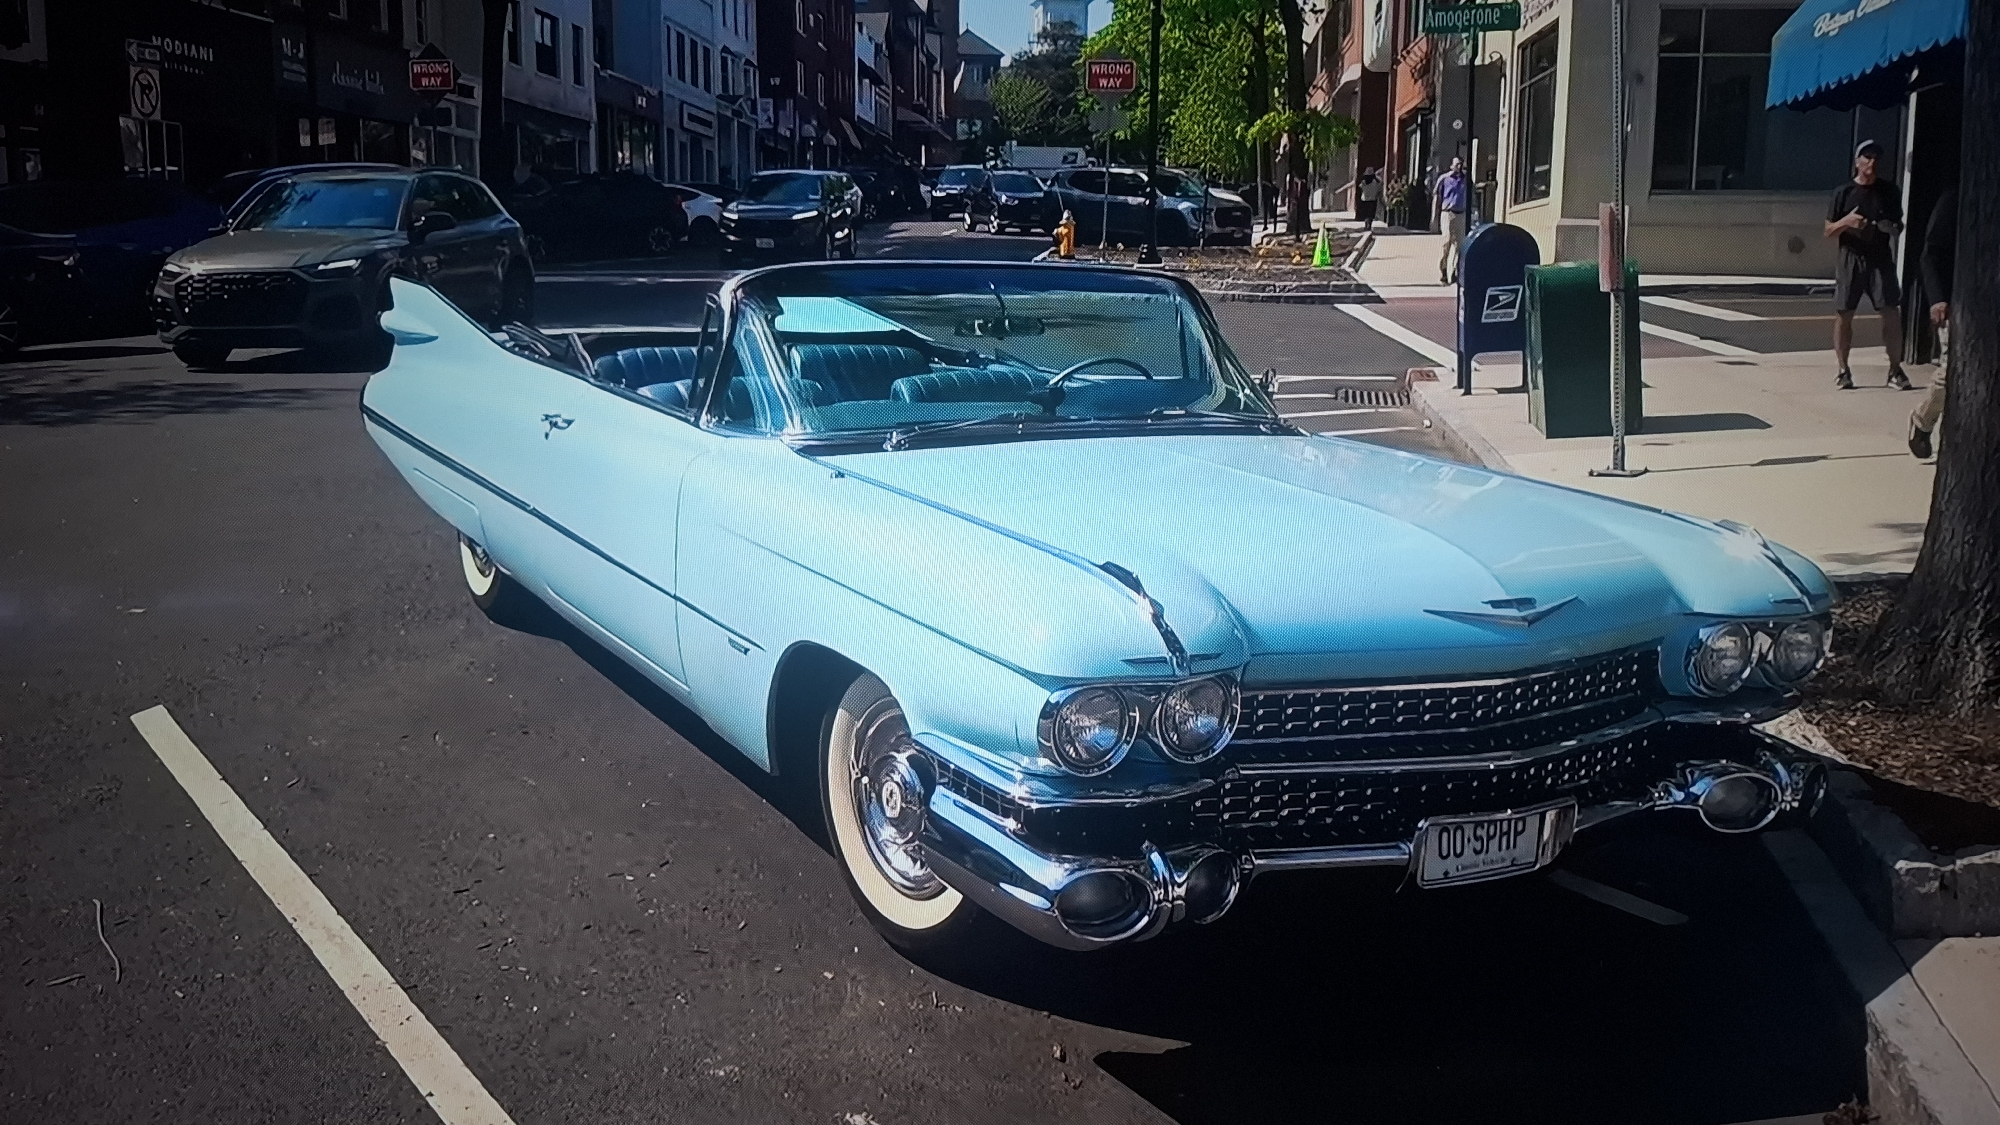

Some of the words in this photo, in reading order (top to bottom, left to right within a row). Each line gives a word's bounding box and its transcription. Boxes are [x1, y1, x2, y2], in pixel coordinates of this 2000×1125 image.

[1426, 8, 1501, 31] Amogerone
[151, 35, 214, 62] MODIANI
[413, 63, 449, 73] WRONG
[1091, 63, 1131, 75] WRONG
[421, 77, 442, 87] WAY
[1098, 77, 1122, 88] WAY
